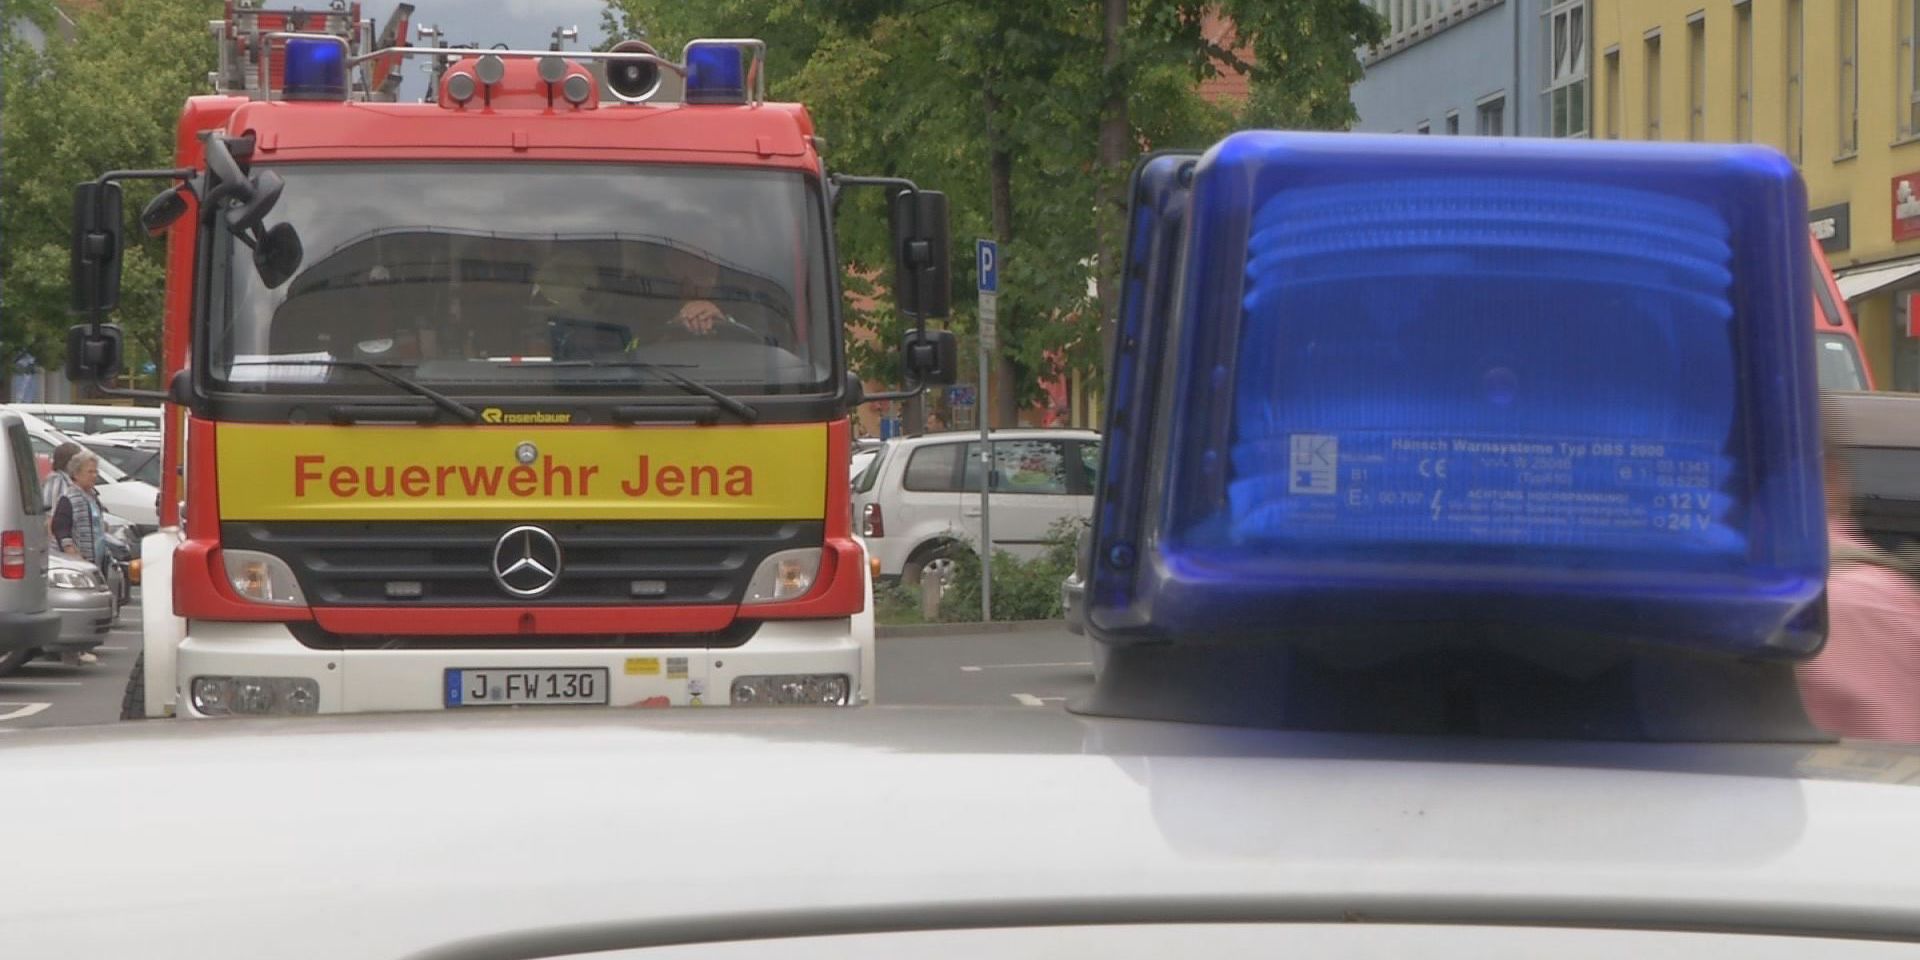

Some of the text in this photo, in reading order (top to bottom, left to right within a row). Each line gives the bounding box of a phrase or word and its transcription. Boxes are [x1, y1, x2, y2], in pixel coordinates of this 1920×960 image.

[982, 247, 993, 285] P
[503, 411, 571, 424] rosenbauer
[1559, 442, 1587, 456] Typ
[294, 455, 754, 497] Feuerwehr Jena
[1669, 493, 1712, 510] 12 V
[1668, 513, 1691, 530] 24
[1695, 513, 1711, 531] V
[472, 674, 593, 699] J FW 130
